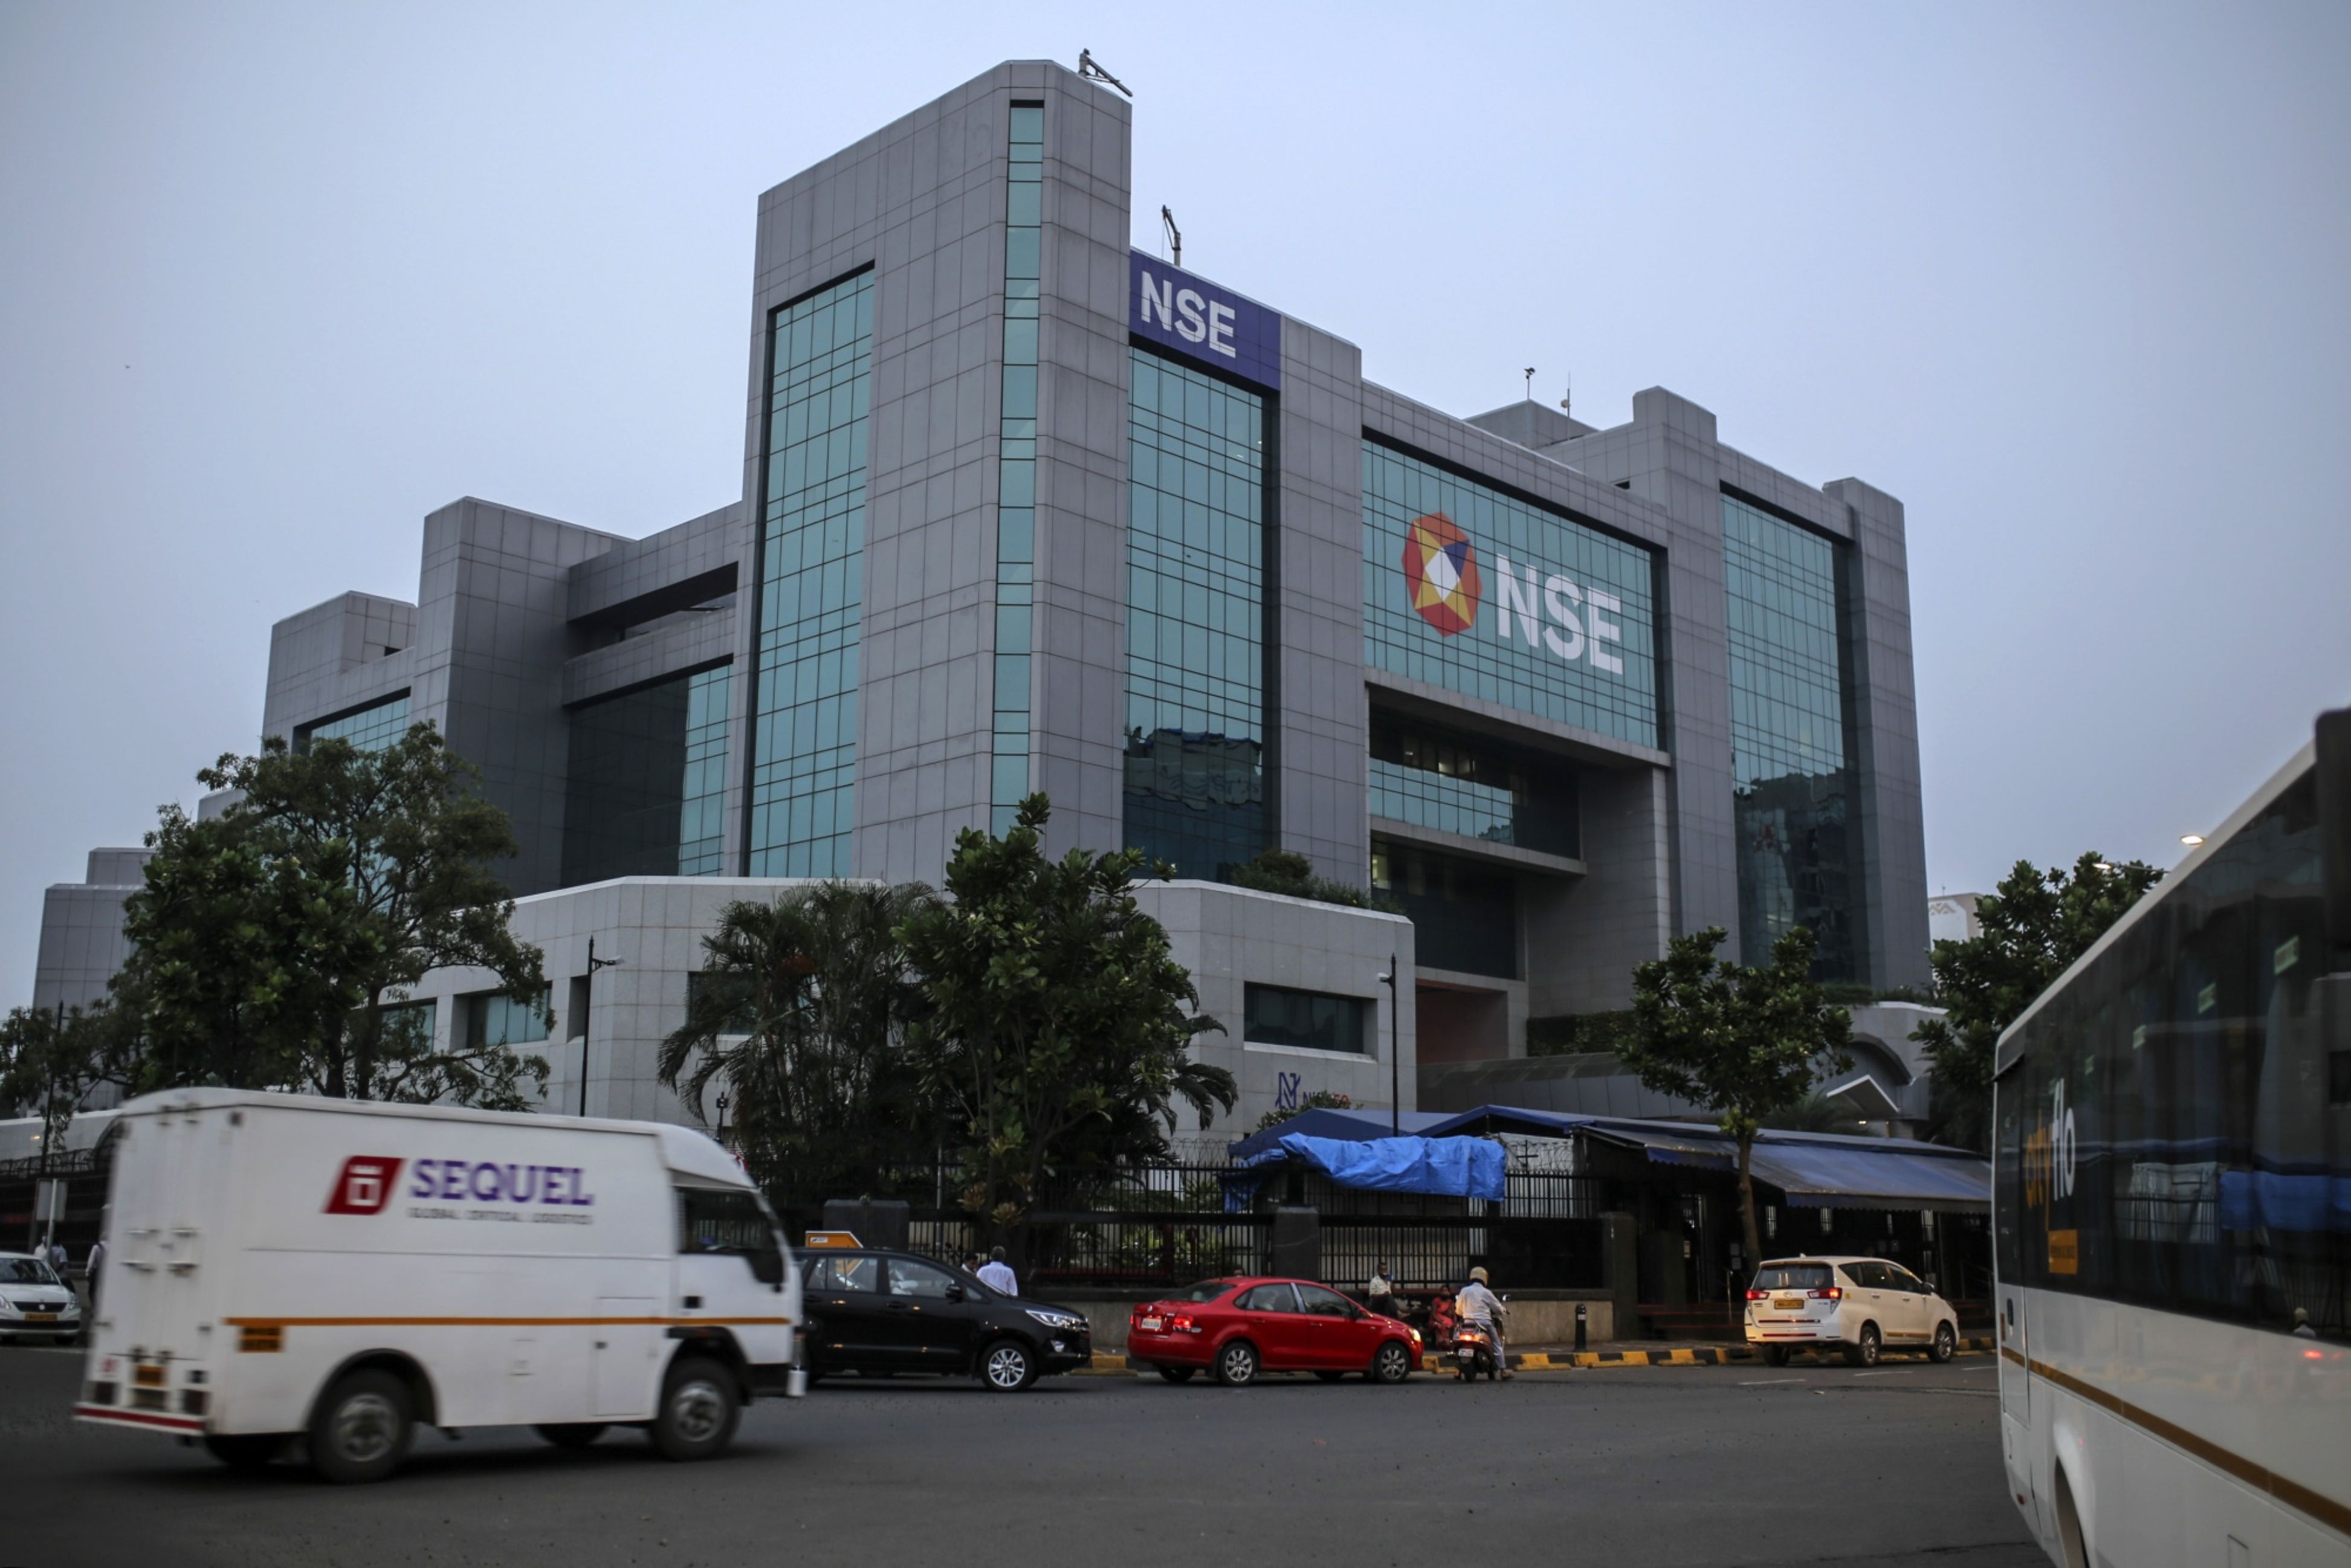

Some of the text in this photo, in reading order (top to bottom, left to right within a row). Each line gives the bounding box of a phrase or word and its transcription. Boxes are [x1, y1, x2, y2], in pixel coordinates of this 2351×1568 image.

[1141, 270, 1236, 358] NSE
[1496, 552, 1623, 676] NSE
[409, 1158, 595, 1205] SEQUEL
